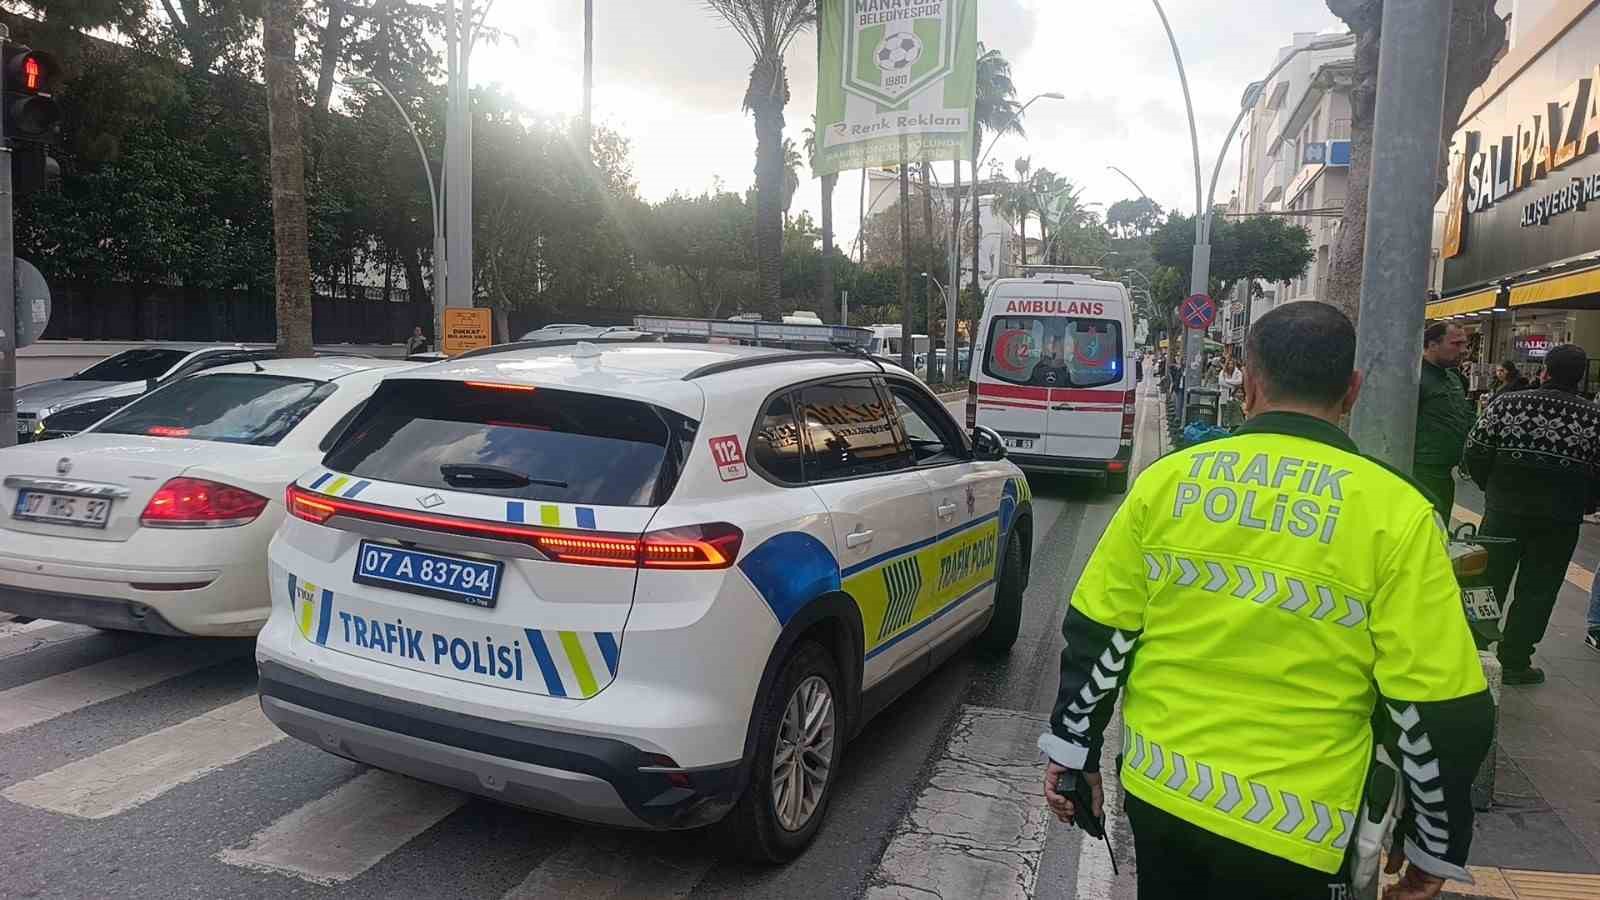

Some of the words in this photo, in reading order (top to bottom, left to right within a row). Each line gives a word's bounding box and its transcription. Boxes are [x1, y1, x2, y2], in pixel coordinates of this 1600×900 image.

[885, 74, 908, 87] 1980
[897, 112, 962, 128] Reklam
[1006, 300, 1105, 316] AMBULANS
[715, 440, 741, 463] 112
[1188, 450, 1352, 502] TRAFİK
[1172, 481, 1341, 545] POLİSİ
[365, 549, 393, 573] 07
[395, 555, 414, 578] A
[419, 558, 490, 592] 83794
[338, 611, 426, 662] TRAFİK
[432, 634, 524, 681] POLİSİ
